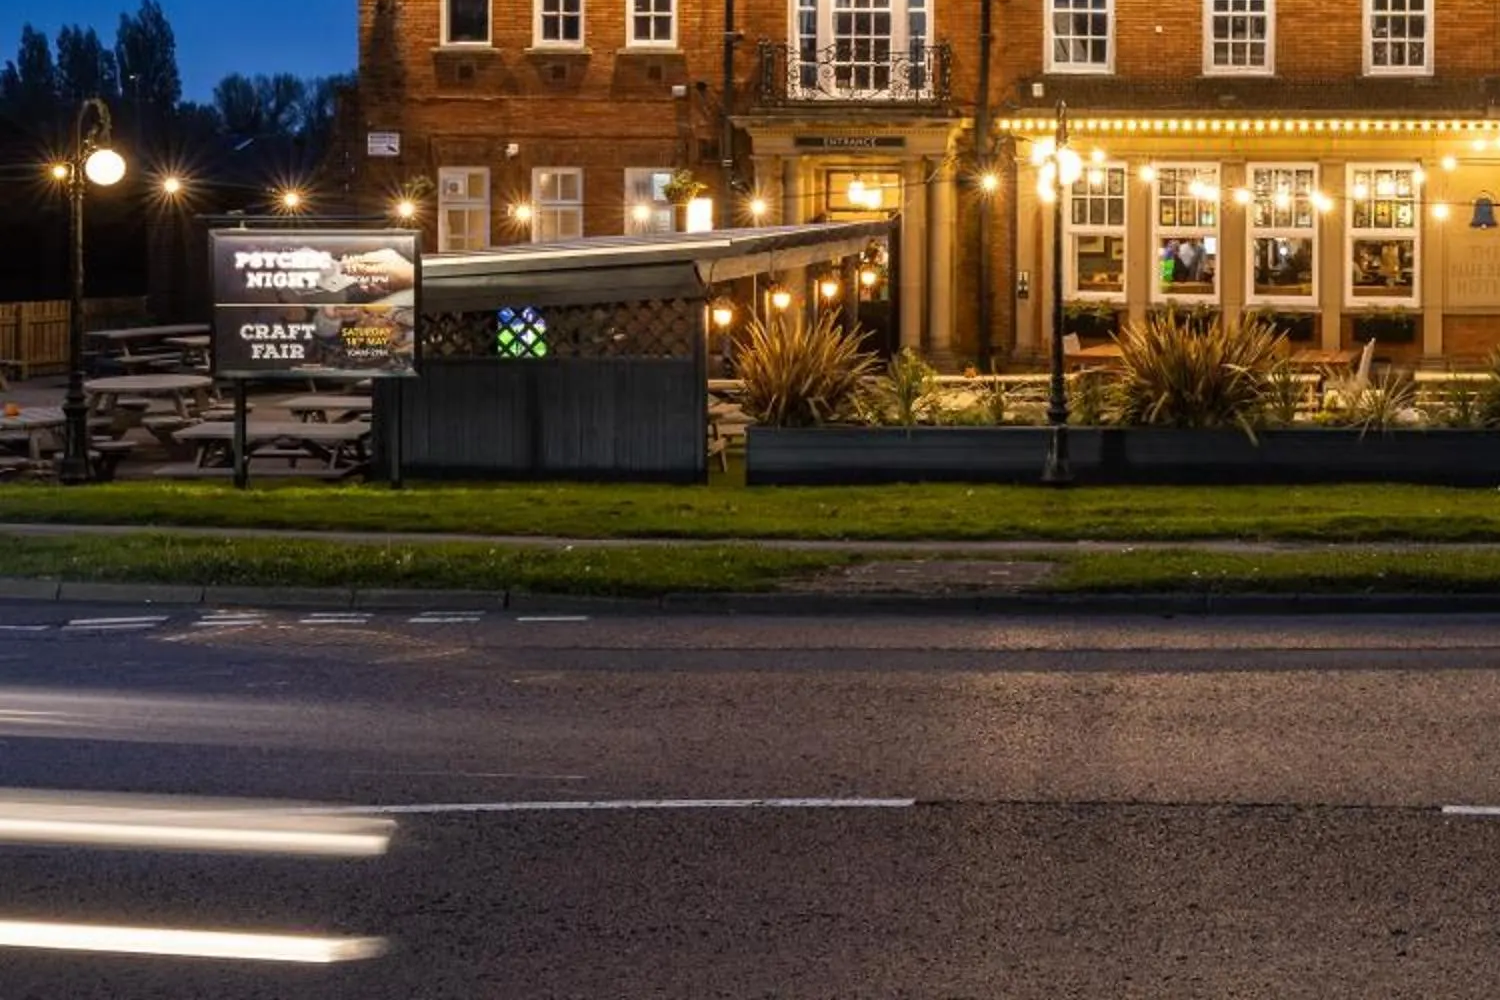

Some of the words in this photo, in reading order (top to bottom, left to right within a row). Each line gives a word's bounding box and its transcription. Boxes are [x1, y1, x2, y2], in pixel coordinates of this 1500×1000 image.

[823, 136, 877, 148] ENTRANCE
[247, 272, 320, 288] NIGHT
[240, 324, 315, 340] CRAFT
[251, 343, 305, 359] FAIR
